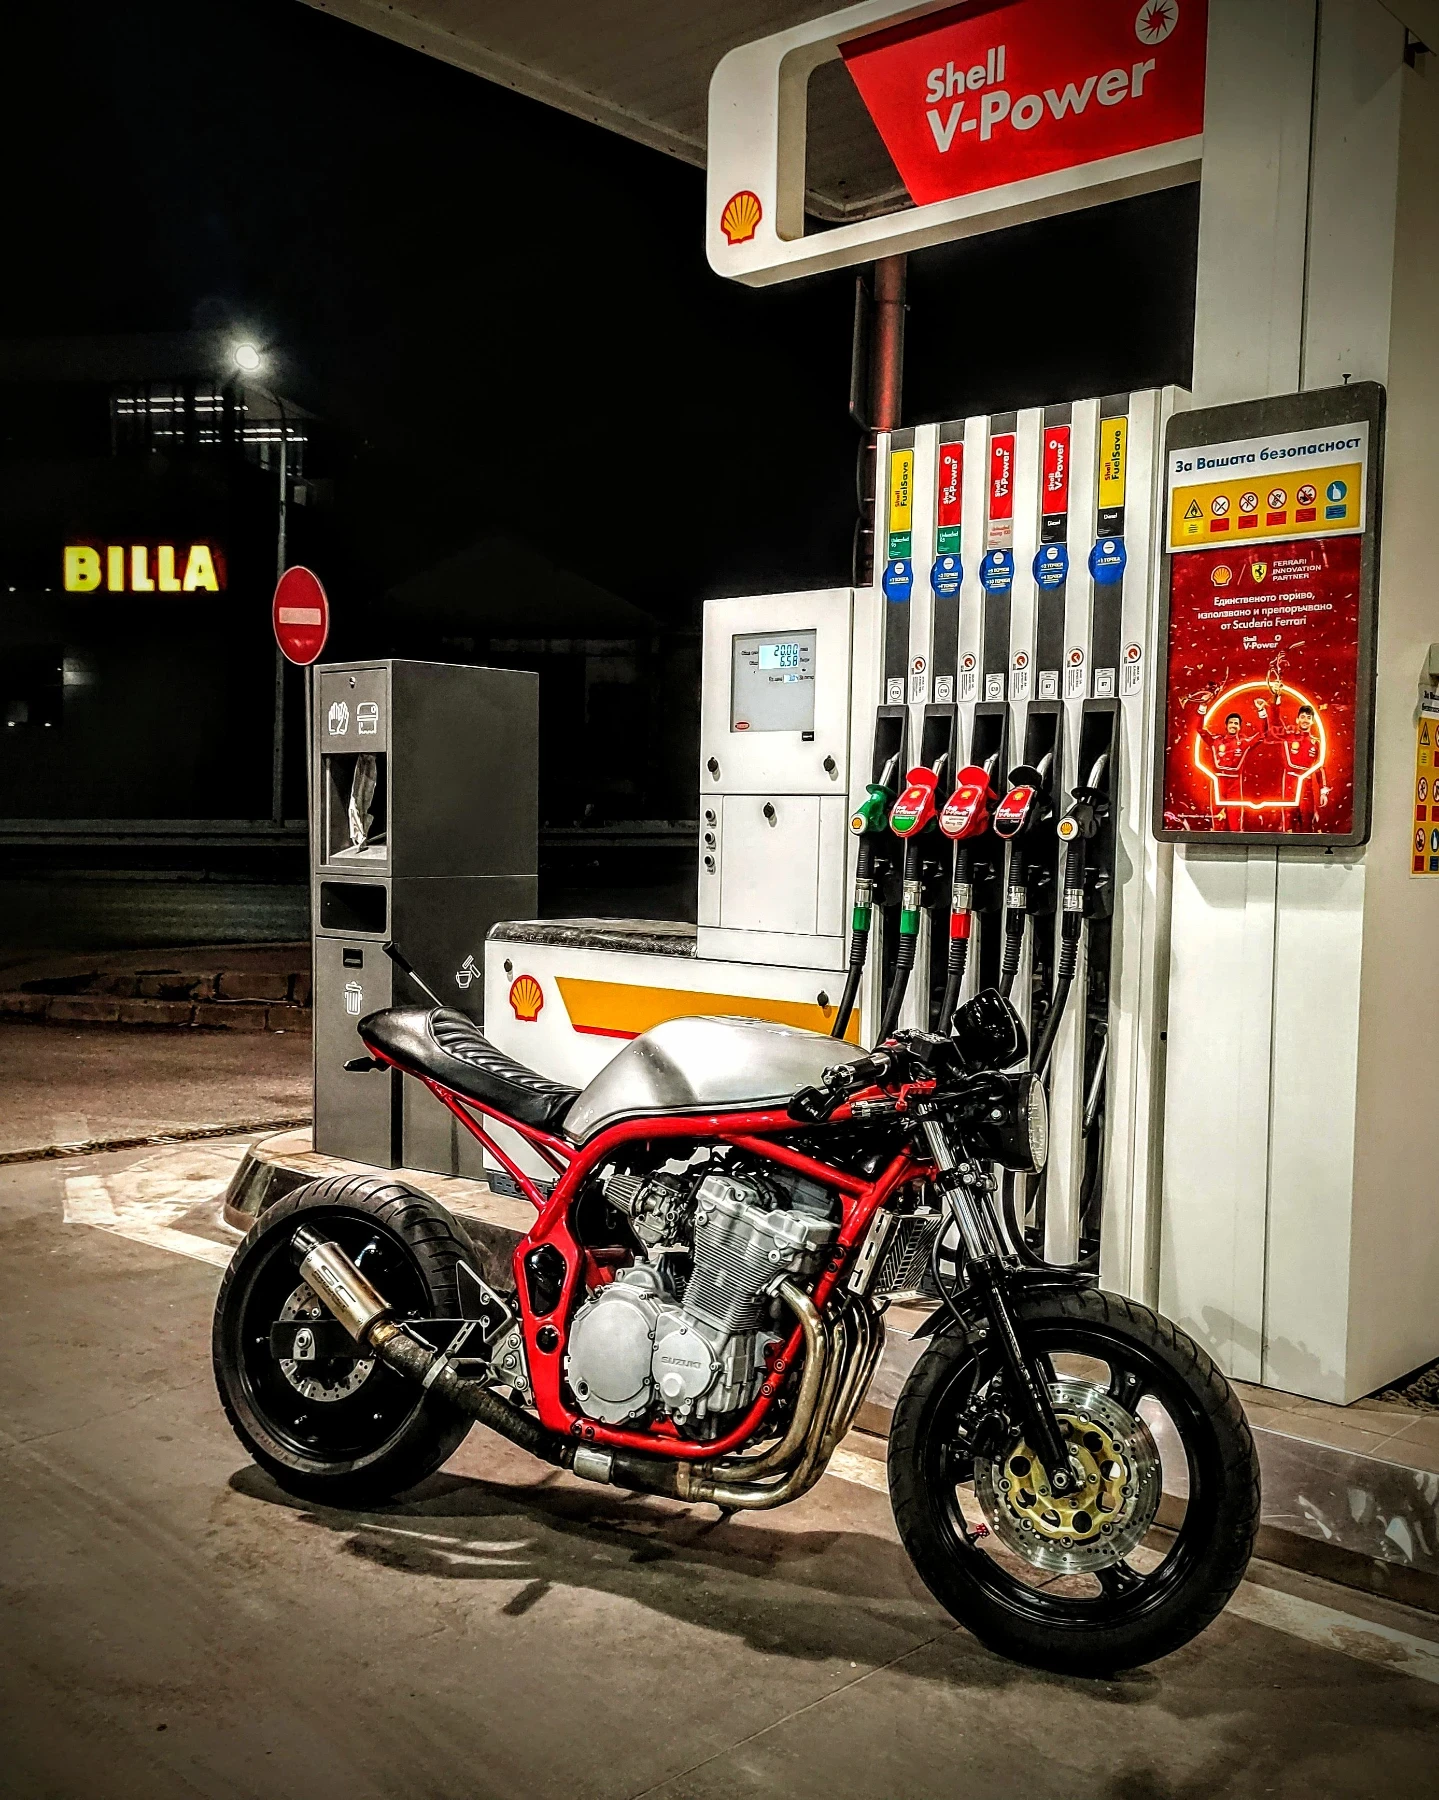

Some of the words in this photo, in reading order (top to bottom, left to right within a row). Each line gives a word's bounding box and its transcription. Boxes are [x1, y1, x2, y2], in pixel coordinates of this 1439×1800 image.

[926, 45, 1006, 103] Shell
[926, 58, 1156, 153] V-Power
[1111, 430, 1122, 480] FuelSave
[1175, 460, 1193, 473] За
[1197, 452, 1256, 470] Вашата
[1259, 437, 1362, 462] безопасност
[1000, 449, 1010, 497] V-Power
[1054, 442, 1064, 491] V-Power
[900, 461, 909, 507] FuelSave
[949, 458, 958, 505] V-Power
[1047, 472, 1055, 492] Shell
[64, 545, 219, 592] BILLA
[1272, 558, 1307, 568] FERRARI
[1272, 564, 1322, 575] INNOVATION
[1272, 573, 1310, 582] PARTNER
[1213, 595, 1277, 606] Единственото
[1278, 591, 1316, 602] гориво,
[1253, 607, 1260, 615] и
[1261, 603, 1333, 615] препоръчвано
[1232, 617, 1273, 630] Scuderia
[1274, 615, 1307, 627] Ferrari
[773, 644, 799, 656] 20.00
[1243, 642, 1279, 650] V-Power
[780, 655, 798, 667] 6.58
[316, 1265, 356, 1308] SC
[661, 1356, 702, 1369] SUZUKI
